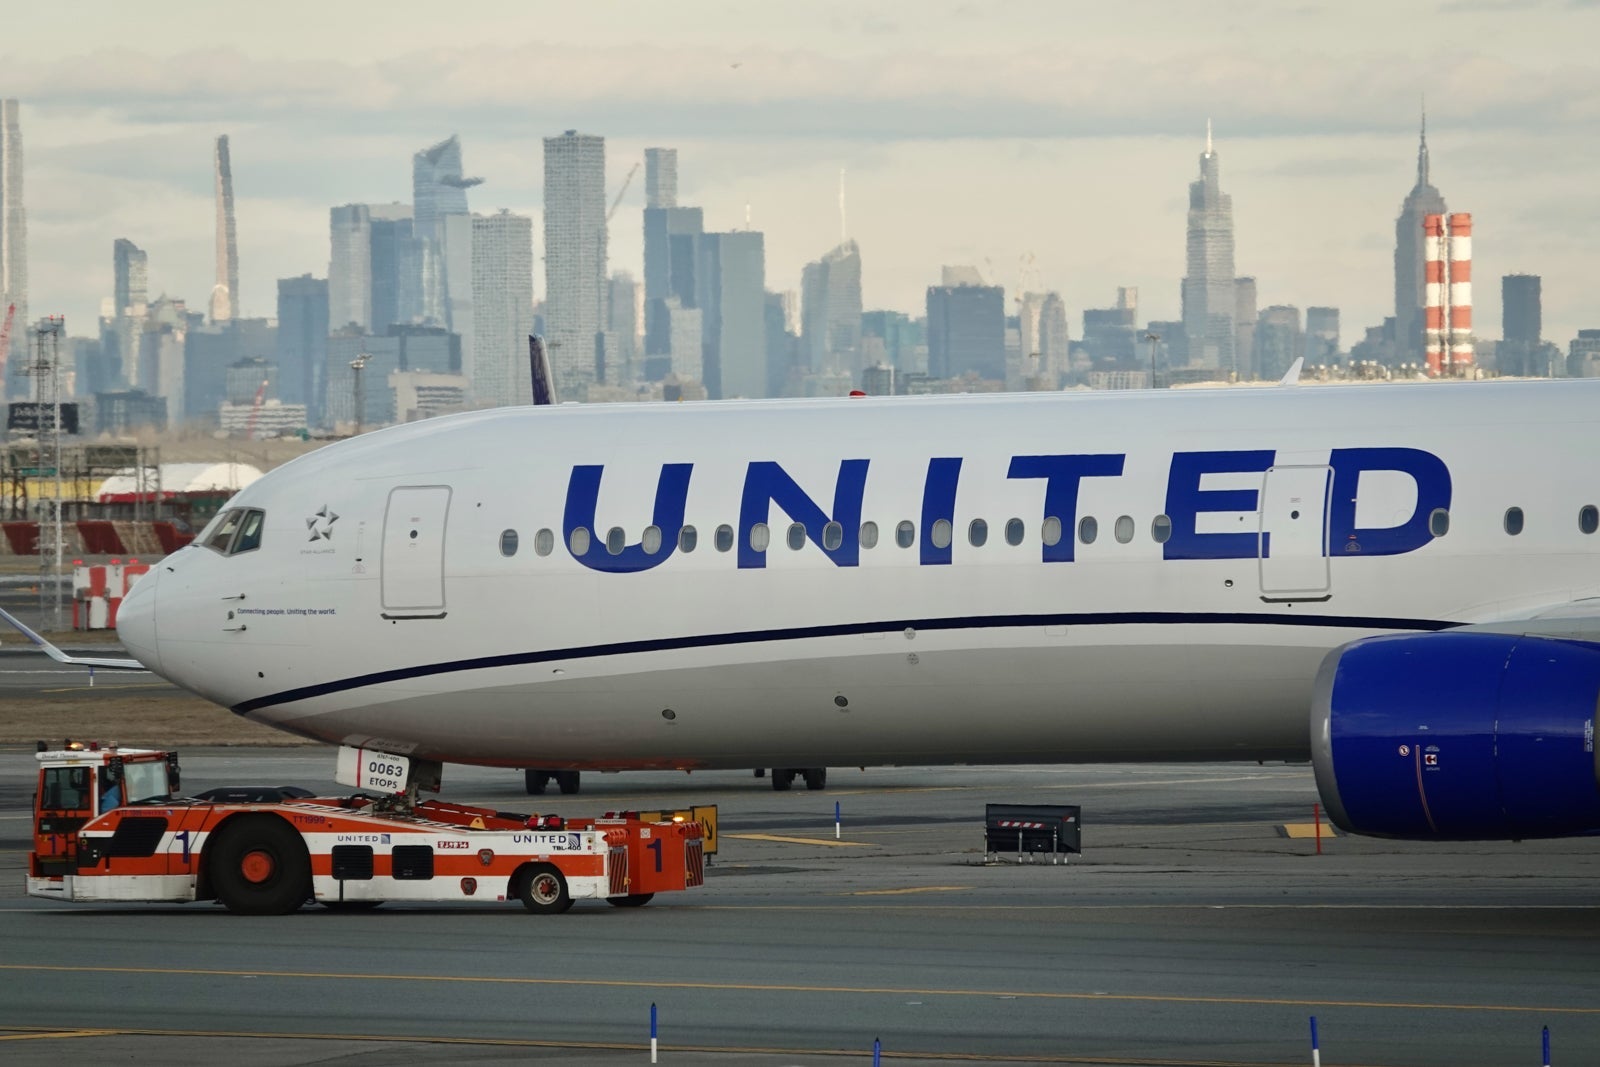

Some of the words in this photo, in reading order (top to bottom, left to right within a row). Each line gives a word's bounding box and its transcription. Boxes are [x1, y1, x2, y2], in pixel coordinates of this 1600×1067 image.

[564, 447, 1451, 573] UNITED
[286, 608, 307, 616] Uniting
[369, 761, 403, 777] 0063
[369, 777, 398, 789] ETOPS
[175, 830, 189, 864] 1
[513, 835, 567, 844] UNITED
[646, 838, 662, 872] 1
